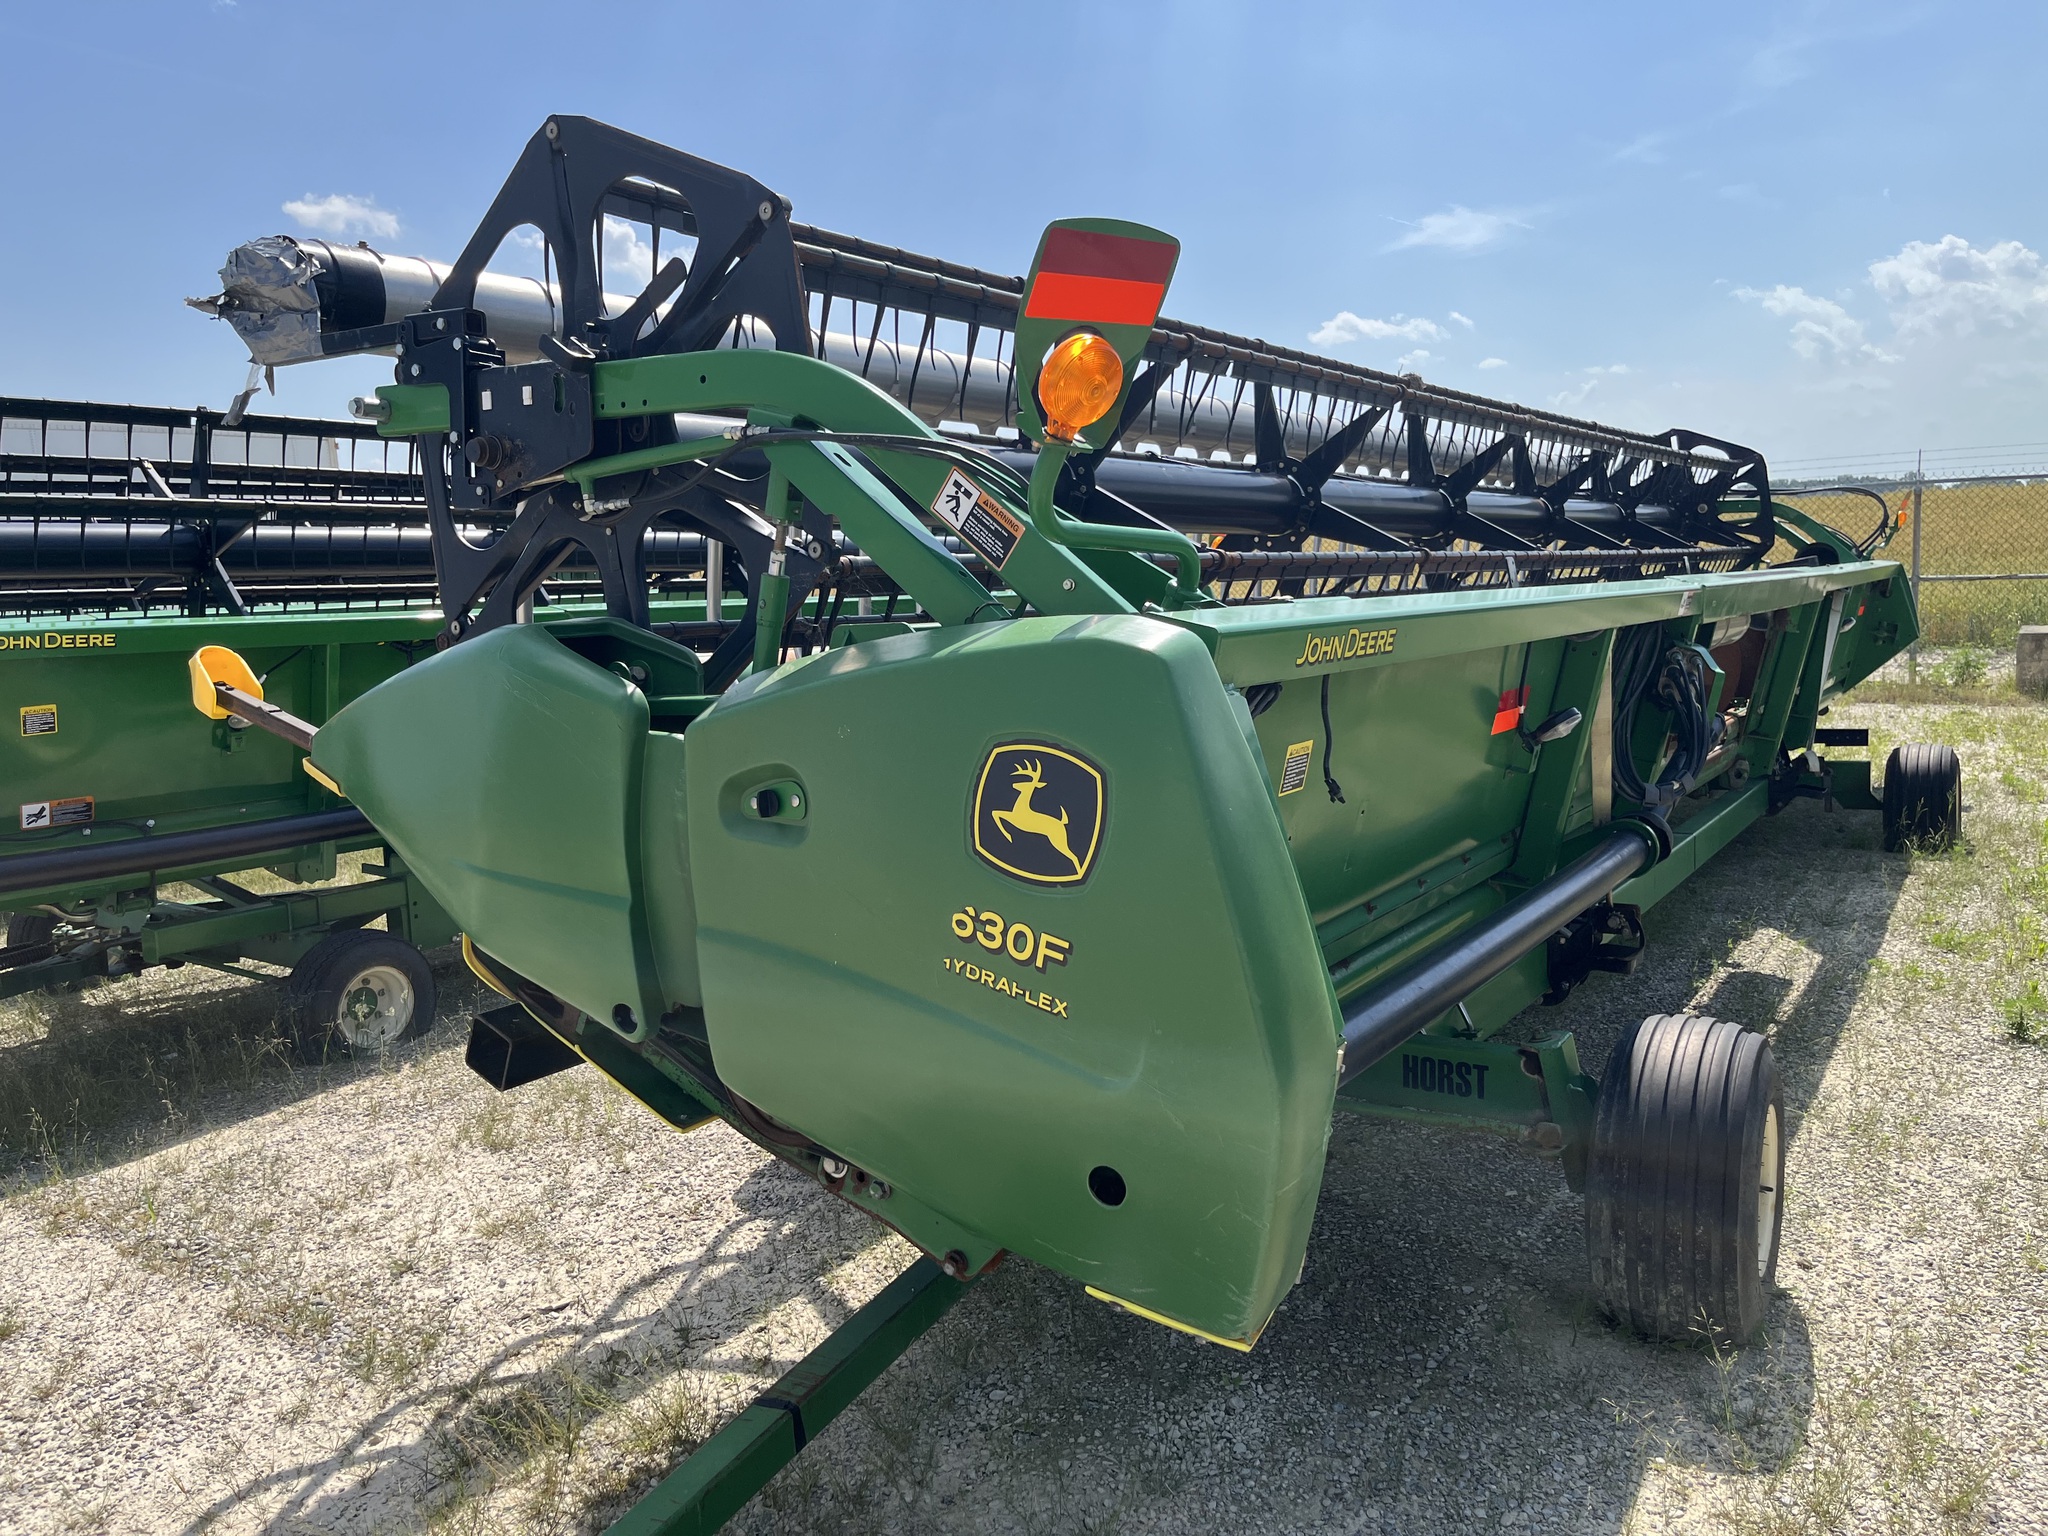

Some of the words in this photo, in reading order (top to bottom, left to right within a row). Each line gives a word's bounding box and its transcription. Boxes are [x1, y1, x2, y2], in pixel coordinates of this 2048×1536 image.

[989, 502, 1020, 533] WARNING
[44, 632, 117, 649] DEERE
[1296, 632, 1346, 665] JOHN
[1343, 628, 1397, 658] DEERE
[951, 906, 1071, 969] 630F
[1402, 1053, 1490, 1100] HORST
